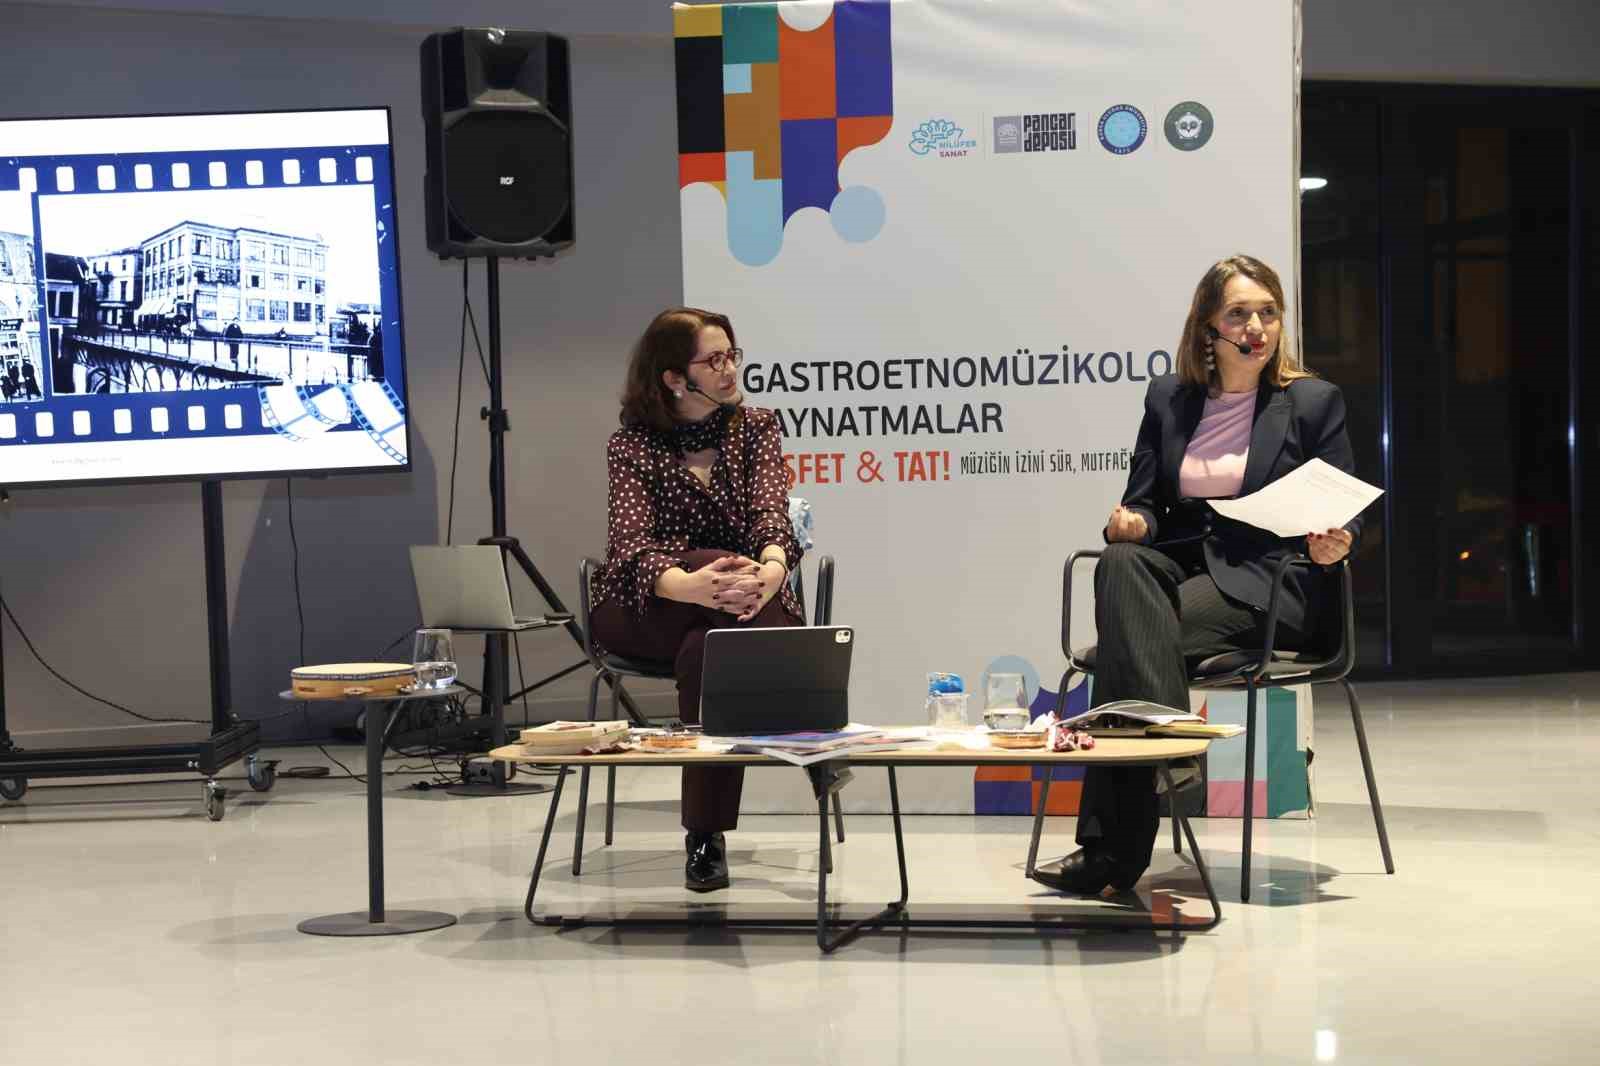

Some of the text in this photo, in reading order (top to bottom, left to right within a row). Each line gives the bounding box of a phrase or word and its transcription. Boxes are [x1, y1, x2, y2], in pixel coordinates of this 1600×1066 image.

[742, 344, 1172, 393] GASTROETNOMÜZİKOLO
[774, 402, 1004, 438] AYNATMALAR
[856, 450, 885, 483] &
[893, 450, 951, 482] TAT!
[960, 451, 1011, 475] MÜZİĞİN
[1015, 450, 1046, 473] İZİNİ
[1049, 449, 1077, 474] SÜR,
